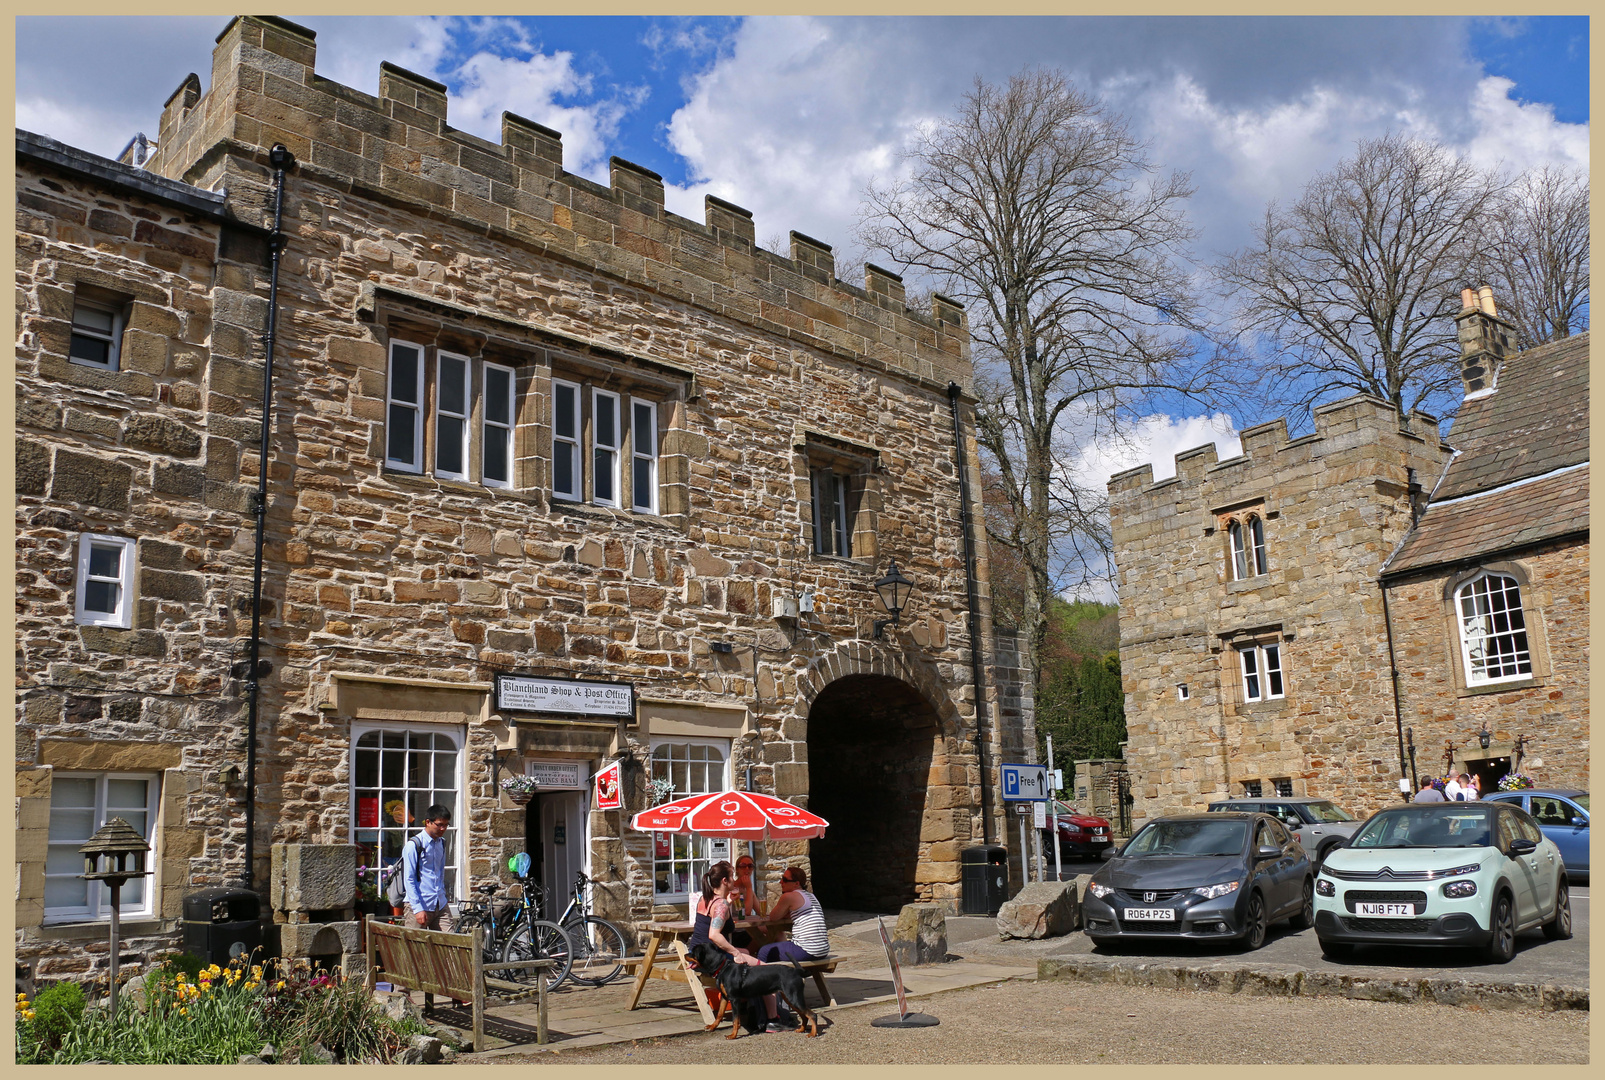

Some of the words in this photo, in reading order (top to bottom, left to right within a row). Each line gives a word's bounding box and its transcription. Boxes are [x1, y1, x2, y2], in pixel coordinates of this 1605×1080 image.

[503, 681, 549, 694] Blanchland
[551, 685, 572, 697] Shop
[574, 687, 582, 697] &
[584, 687, 603, 699] Post
[605, 689, 628, 700] Office
[1007, 772, 1017, 792] P
[1020, 776, 1035, 787] Free
[1128, 909, 1151, 919] RO64
[1153, 910, 1171, 919] PZS
[1362, 904, 1385, 914] NJ18
[1387, 905, 1408, 915] FTZ
